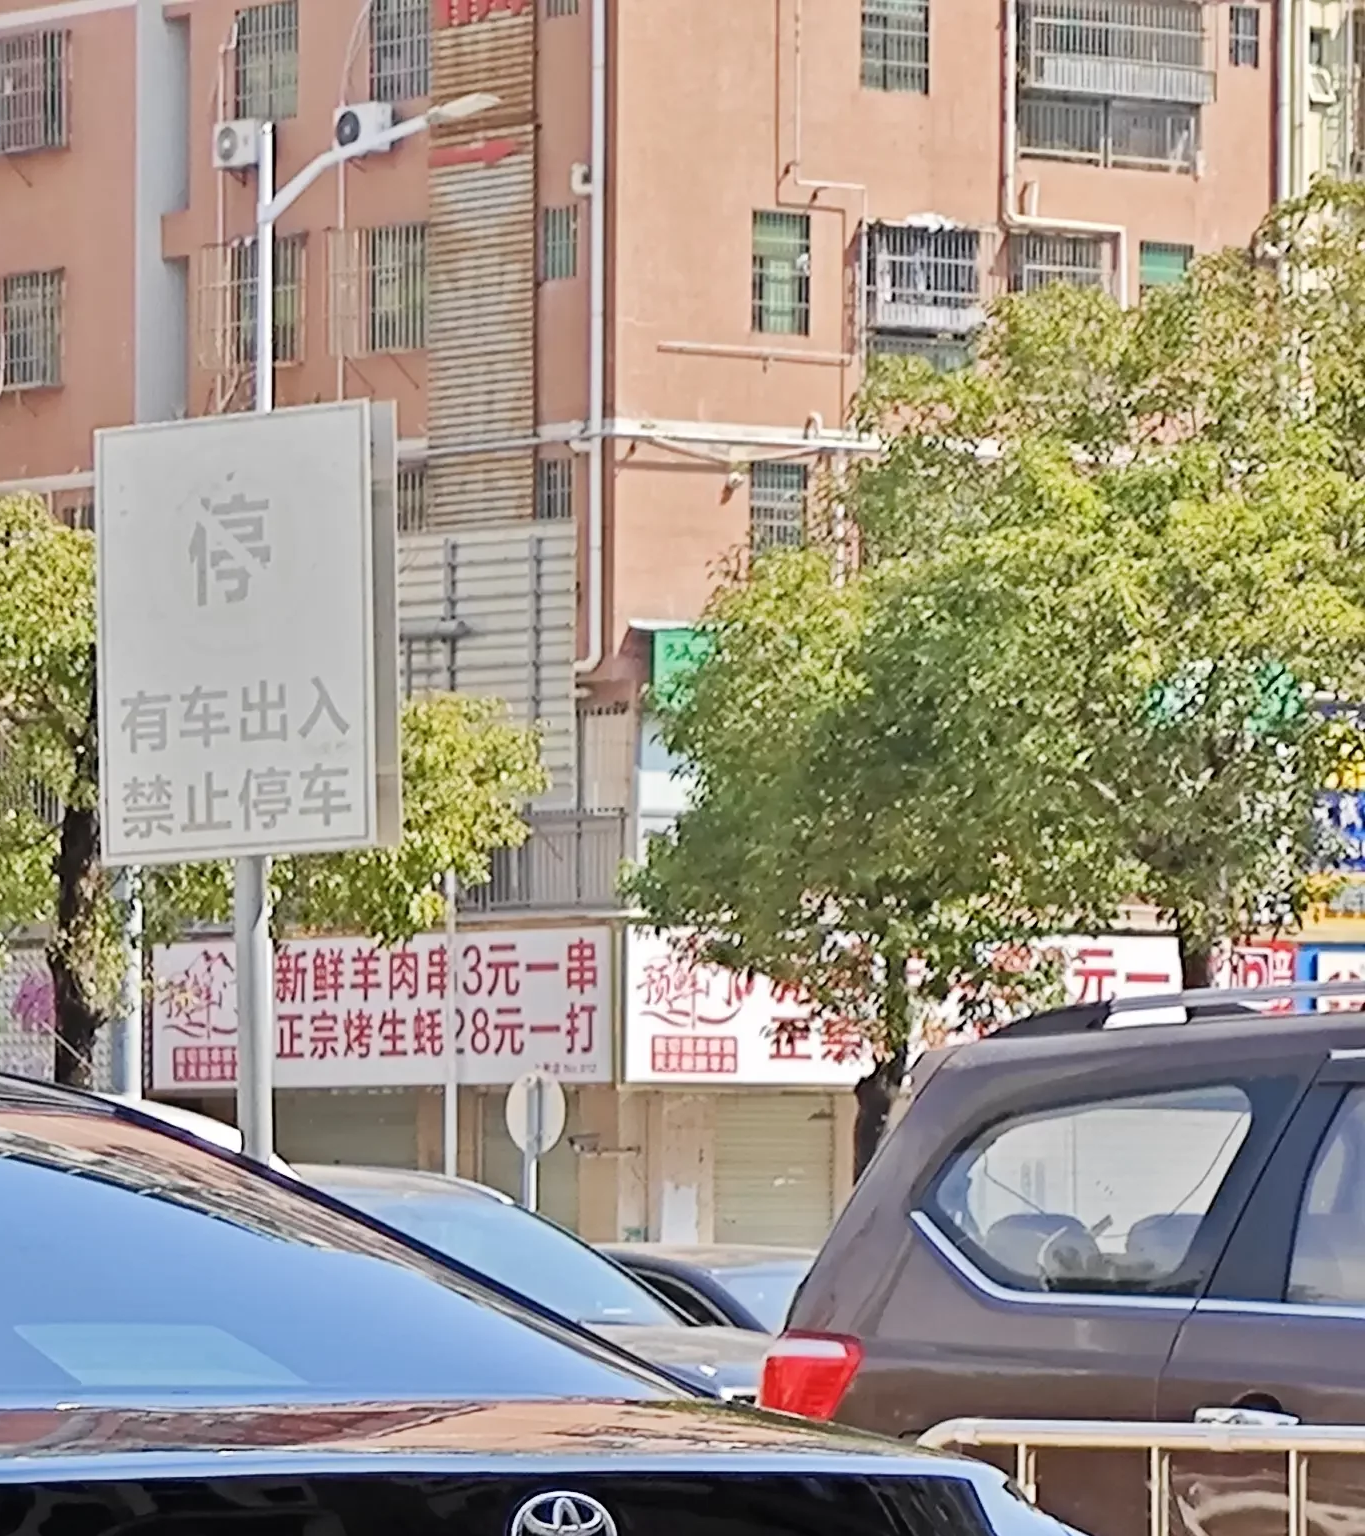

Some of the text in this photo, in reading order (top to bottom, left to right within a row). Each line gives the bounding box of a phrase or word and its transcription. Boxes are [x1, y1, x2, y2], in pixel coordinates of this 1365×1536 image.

[120, 676, 351, 754] 有车出入
[122, 763, 352, 840] 禁止停车
